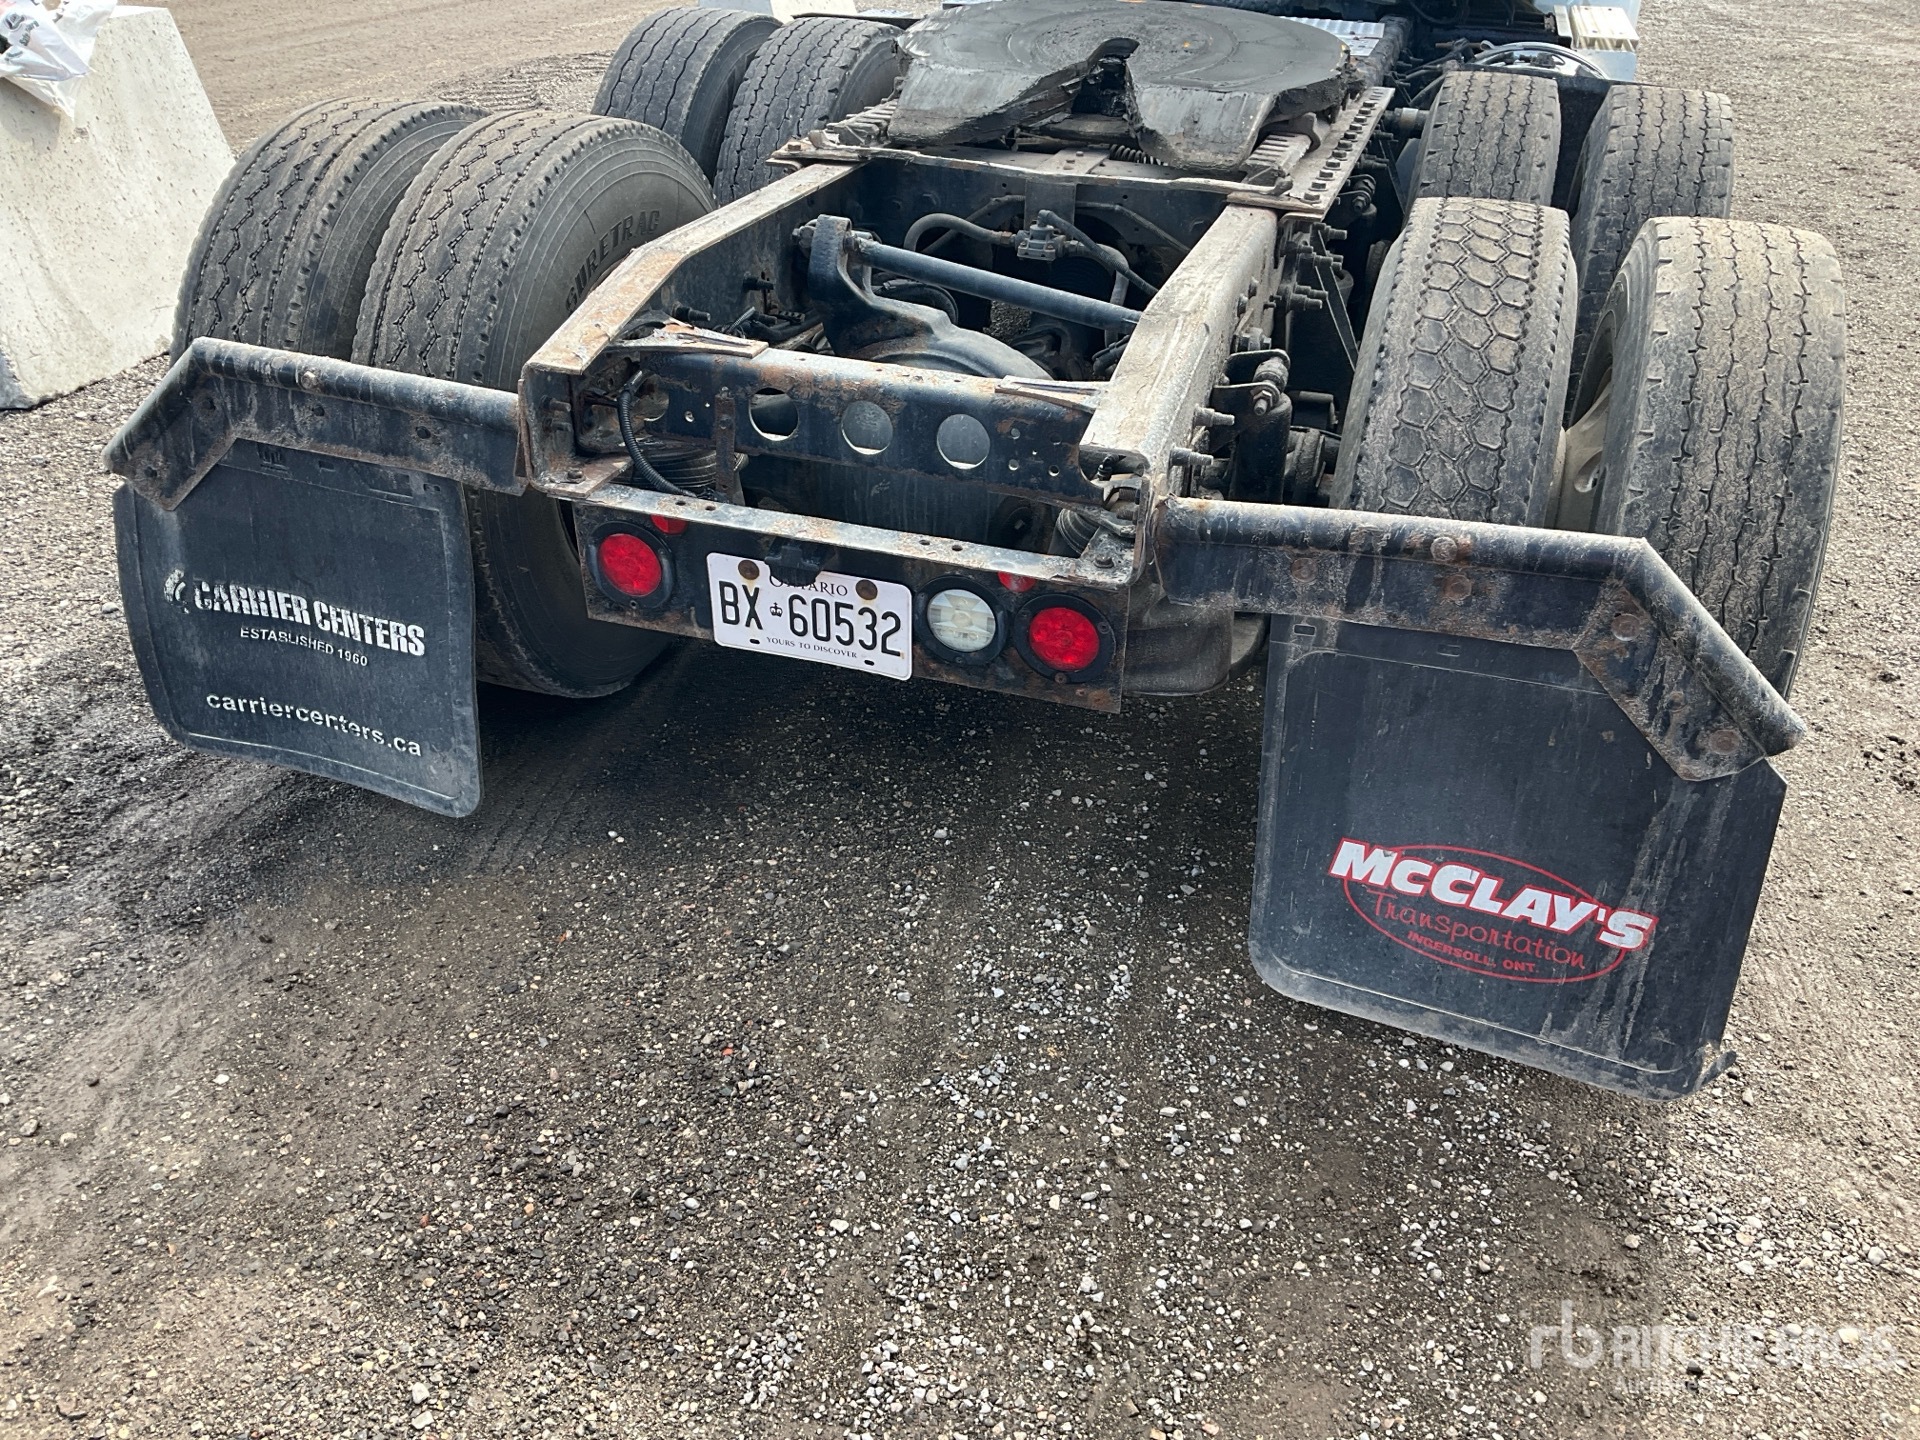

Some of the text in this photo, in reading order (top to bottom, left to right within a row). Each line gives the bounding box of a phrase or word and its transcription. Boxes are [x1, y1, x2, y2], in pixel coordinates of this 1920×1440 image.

[566, 209, 660, 316] SURETRAC
[194, 579, 425, 656] CARRIER CENTERS
[718, 581, 901, 657] BX 60532
[769, 576, 848, 597] OARIO
[240, 626, 368, 666] ESTABLISHED 1960
[766, 636, 858, 659] YOURS TO DISCOVER
[206, 692, 422, 757] carriercenters.ca
[1366, 888, 1586, 970] Transportation
[1502, 958, 1540, 974] ONT.
